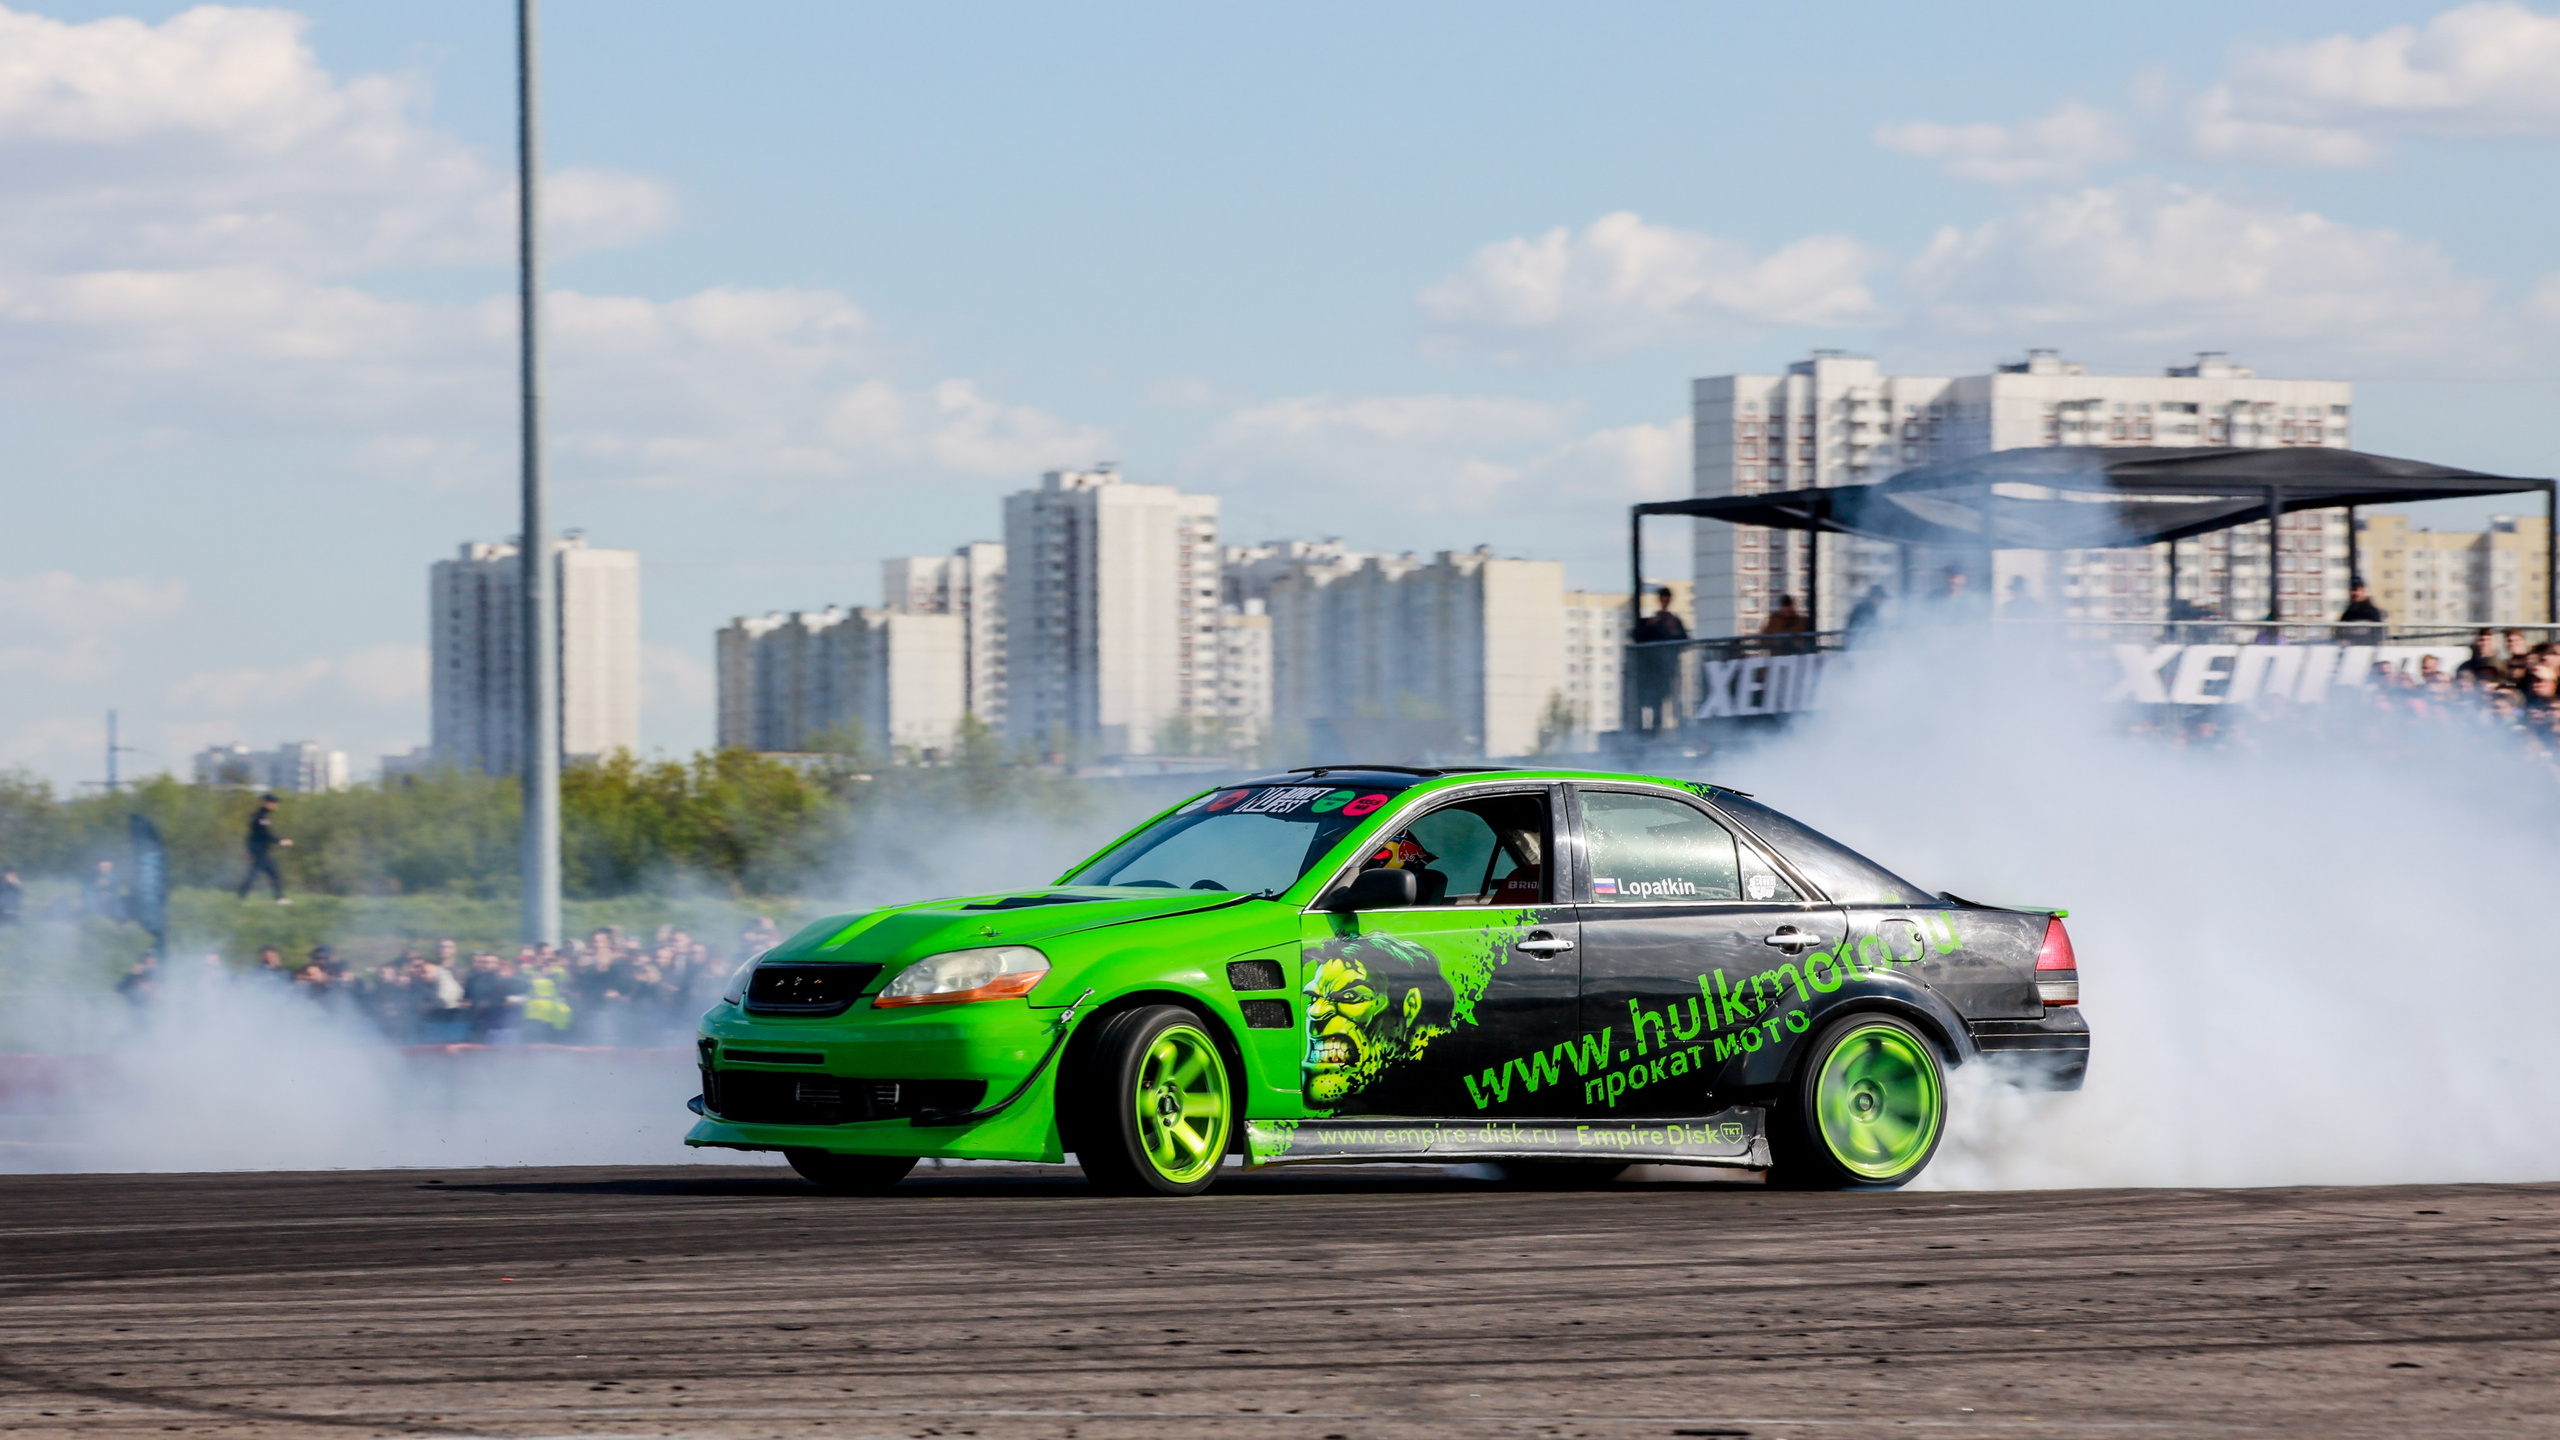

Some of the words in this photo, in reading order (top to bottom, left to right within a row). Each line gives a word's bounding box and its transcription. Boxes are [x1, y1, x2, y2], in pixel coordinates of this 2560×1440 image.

[1268, 800, 1310, 813] FEST
[1617, 878, 1696, 899] Lopatkin
[1463, 911, 1963, 1109] www.hulkmoto.ru
[1585, 1045, 1704, 1108] прокат
[1317, 1123, 1558, 1147] www.empire-disk.ru
[1576, 1124, 1663, 1150] Empire
[1667, 1124, 1721, 1146] Disk
[1723, 1127, 1740, 1136] TKT
